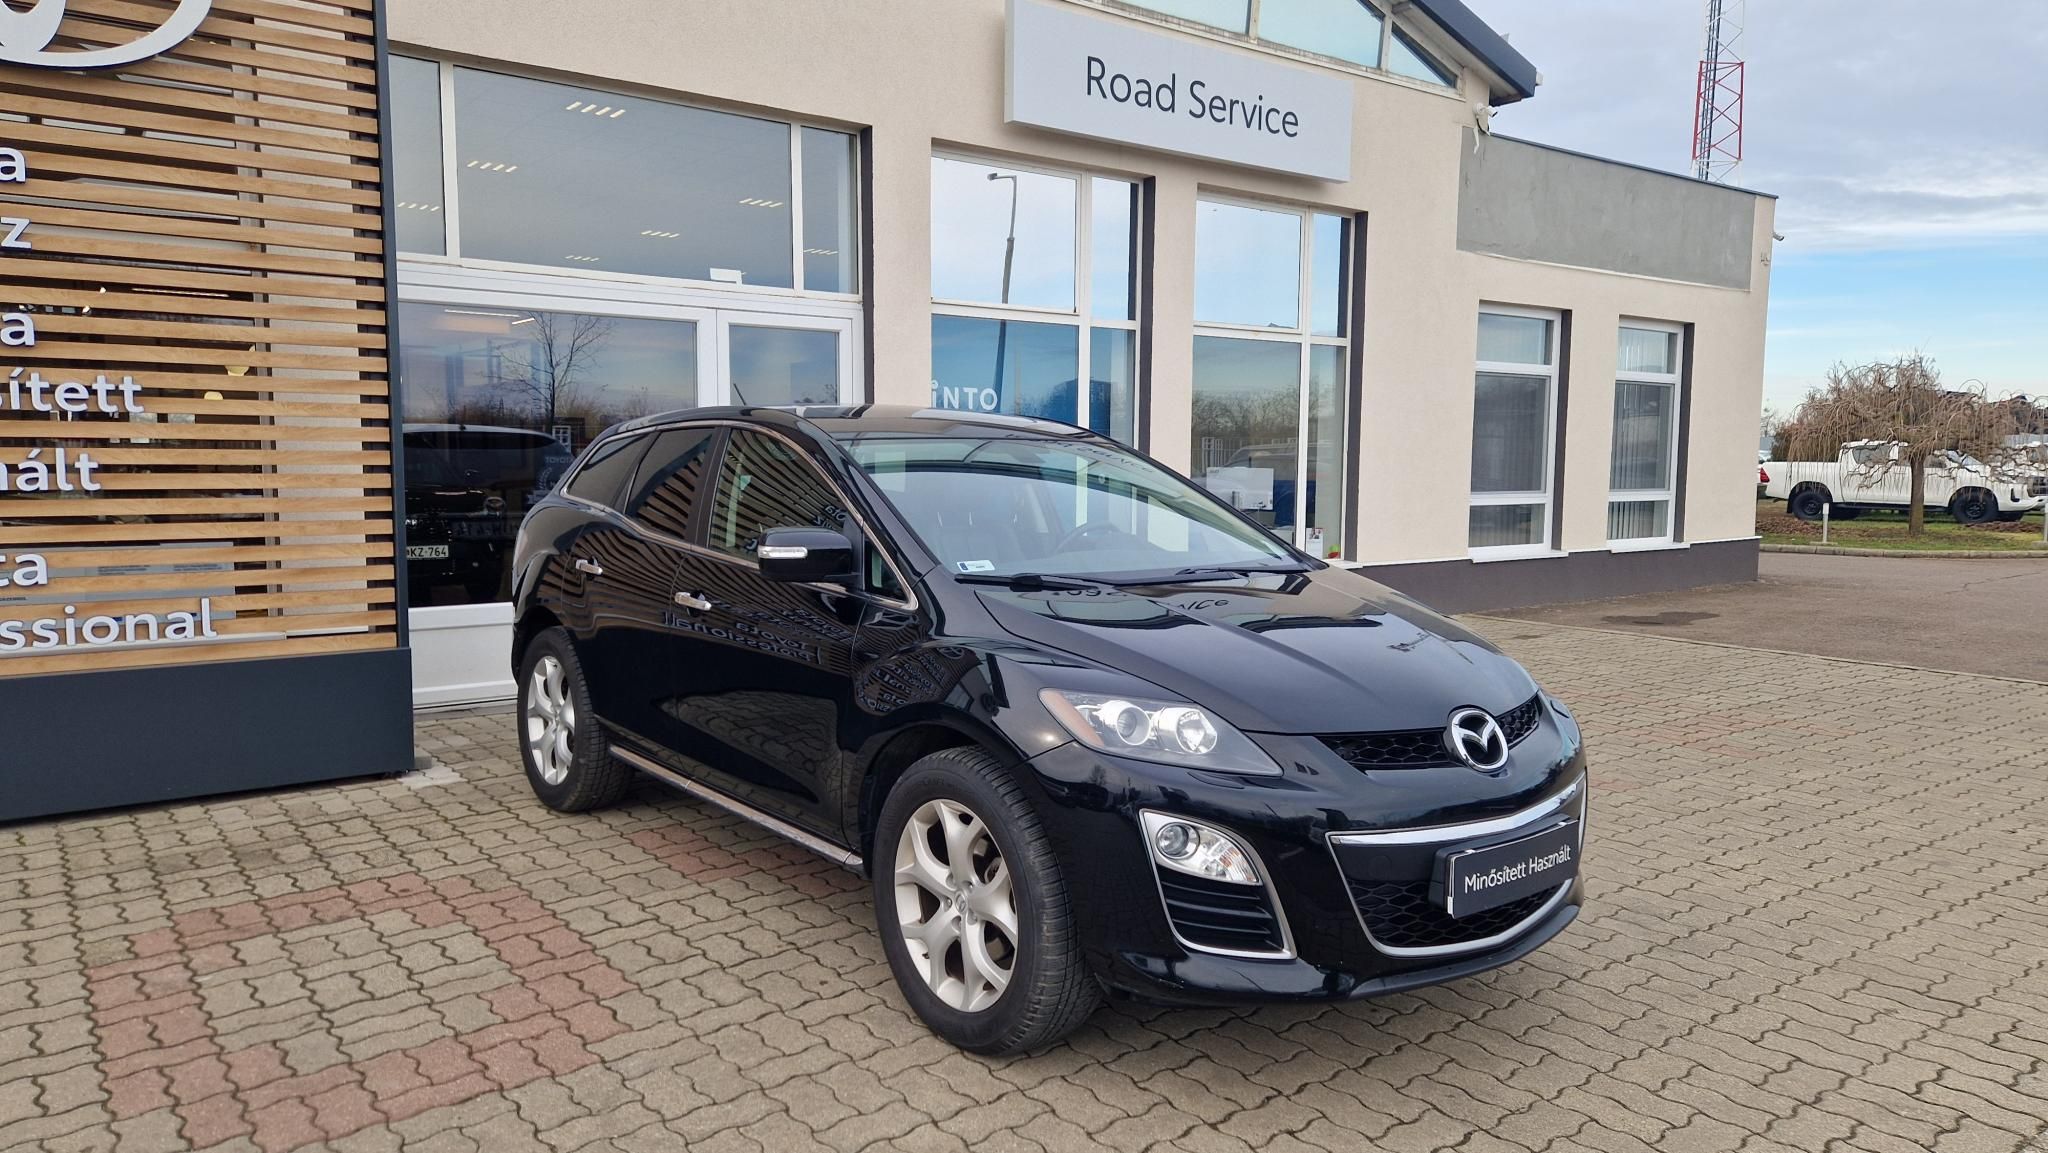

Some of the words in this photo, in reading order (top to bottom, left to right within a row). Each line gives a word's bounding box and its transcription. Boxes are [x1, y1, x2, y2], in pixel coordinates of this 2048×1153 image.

[1086, 55, 1176, 114] Road
[1188, 80, 1299, 138] Service
[0, 367, 145, 413] ített
[1464, 861, 1526, 894] Minősített
[1529, 844, 1571, 875] Használt
